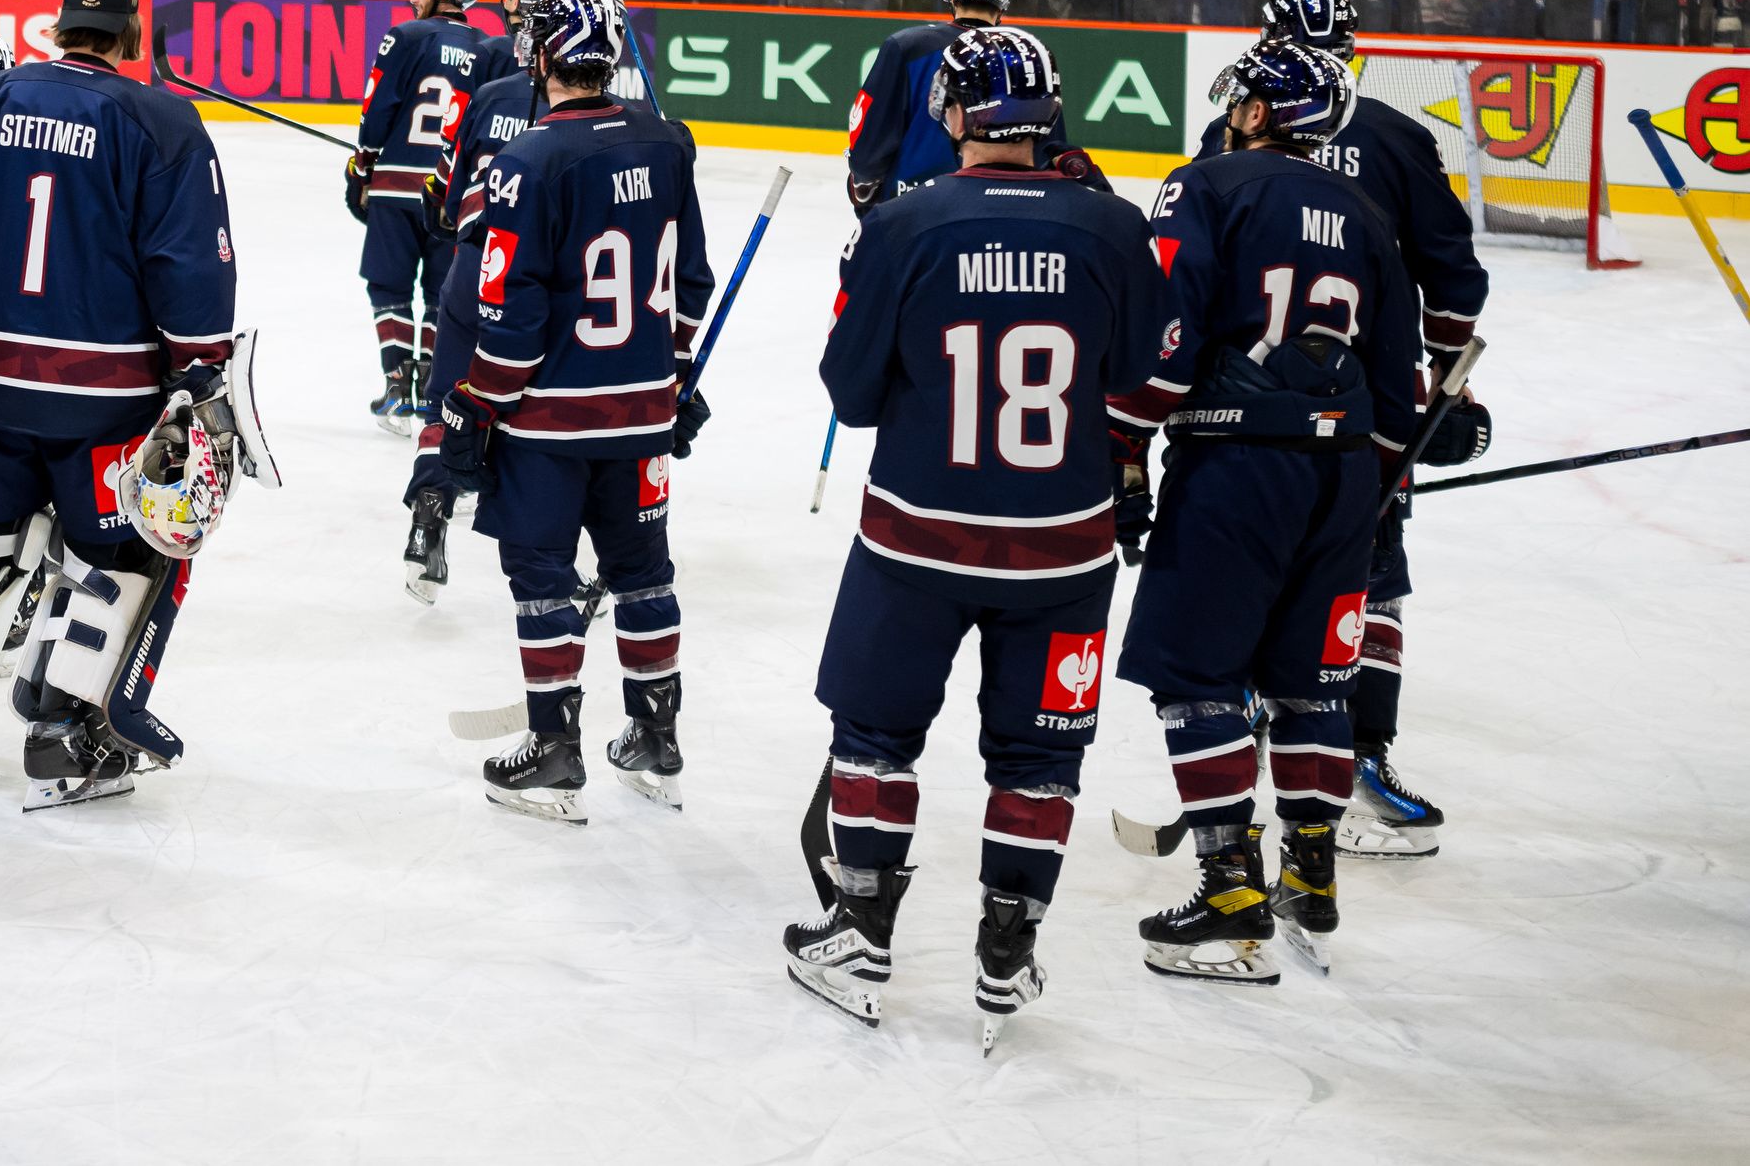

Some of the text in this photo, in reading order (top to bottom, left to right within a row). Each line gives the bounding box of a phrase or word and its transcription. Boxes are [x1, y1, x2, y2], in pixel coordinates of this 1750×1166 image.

[1335, 10, 1349, 21] 92
[167, 1, 371, 100] JOIN
[1284, 43, 1325, 86] STADLER
[666, 36, 1172, 126] SKA
[407, 75, 452, 146] 2
[1272, 98, 1313, 110] STADLER
[0, 113, 97, 160] STETTMER
[209, 158, 220, 195] 1
[489, 168, 522, 208] 94
[612, 166, 652, 204] KIRK
[1153, 182, 1184, 218] 12
[24, 174, 54, 296] 1
[1301, 206, 1346, 251] MIK
[575, 220, 678, 347] 94
[958, 242, 1067, 294] MÜLLER
[945, 324, 1076, 468] 18
[1168, 408, 1244, 425] WARRIOR
[123, 620, 158, 701] WARRIOR
[1035, 712, 1097, 731] STRAUSS
[1383, 790, 1417, 815] BAUER
[993, 896, 1020, 906] CCM
[1176, 909, 1209, 928] BAUER
[807, 931, 856, 963] CCM
